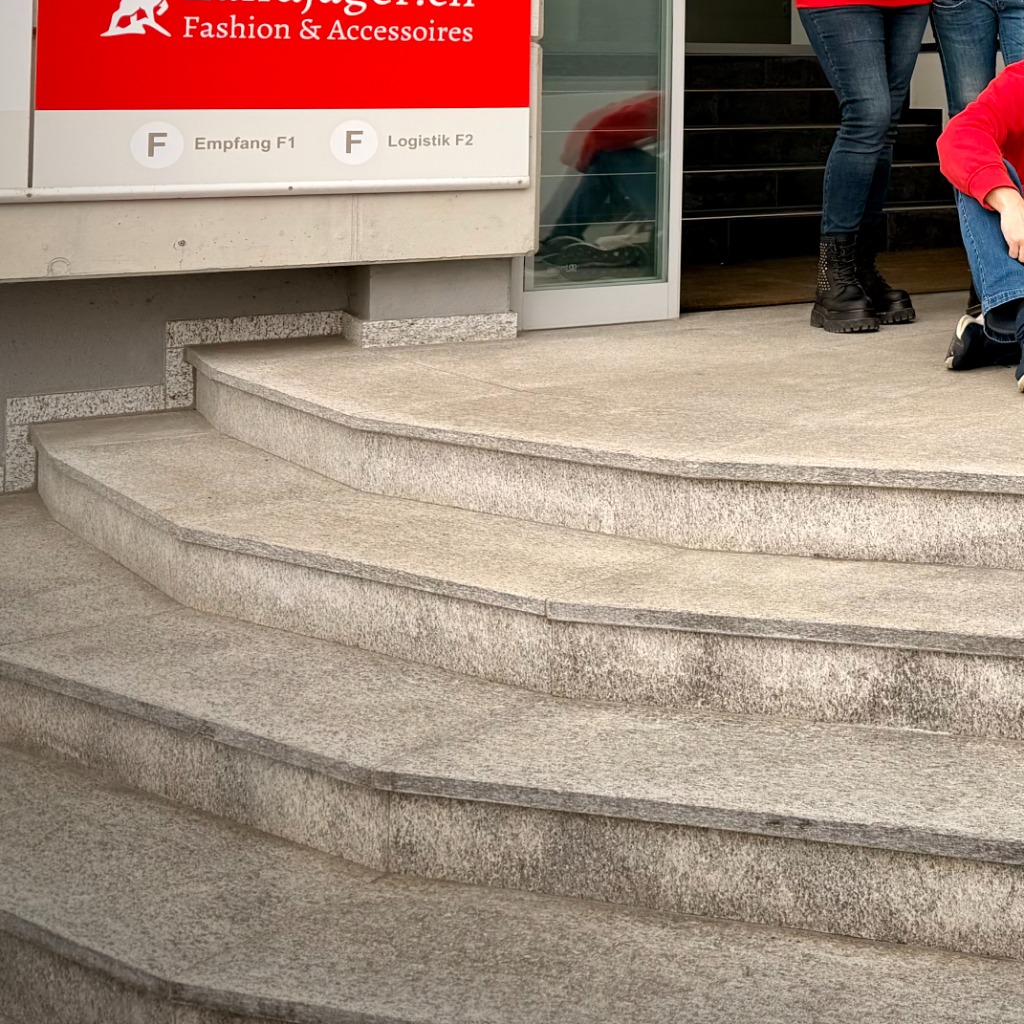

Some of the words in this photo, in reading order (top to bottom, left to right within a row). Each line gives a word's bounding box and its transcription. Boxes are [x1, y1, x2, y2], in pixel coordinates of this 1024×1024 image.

[183, 15, 290, 40] Fashion
[300, 20, 322, 40] &
[327, 20, 473, 42] Accessoires
[148, 132, 168, 157] F
[195, 136, 271, 152] Empfang
[277, 137, 295, 149] F1
[346, 130, 364, 153] F
[388, 134, 451, 151] Logistik
[455, 134, 473, 146] F2
